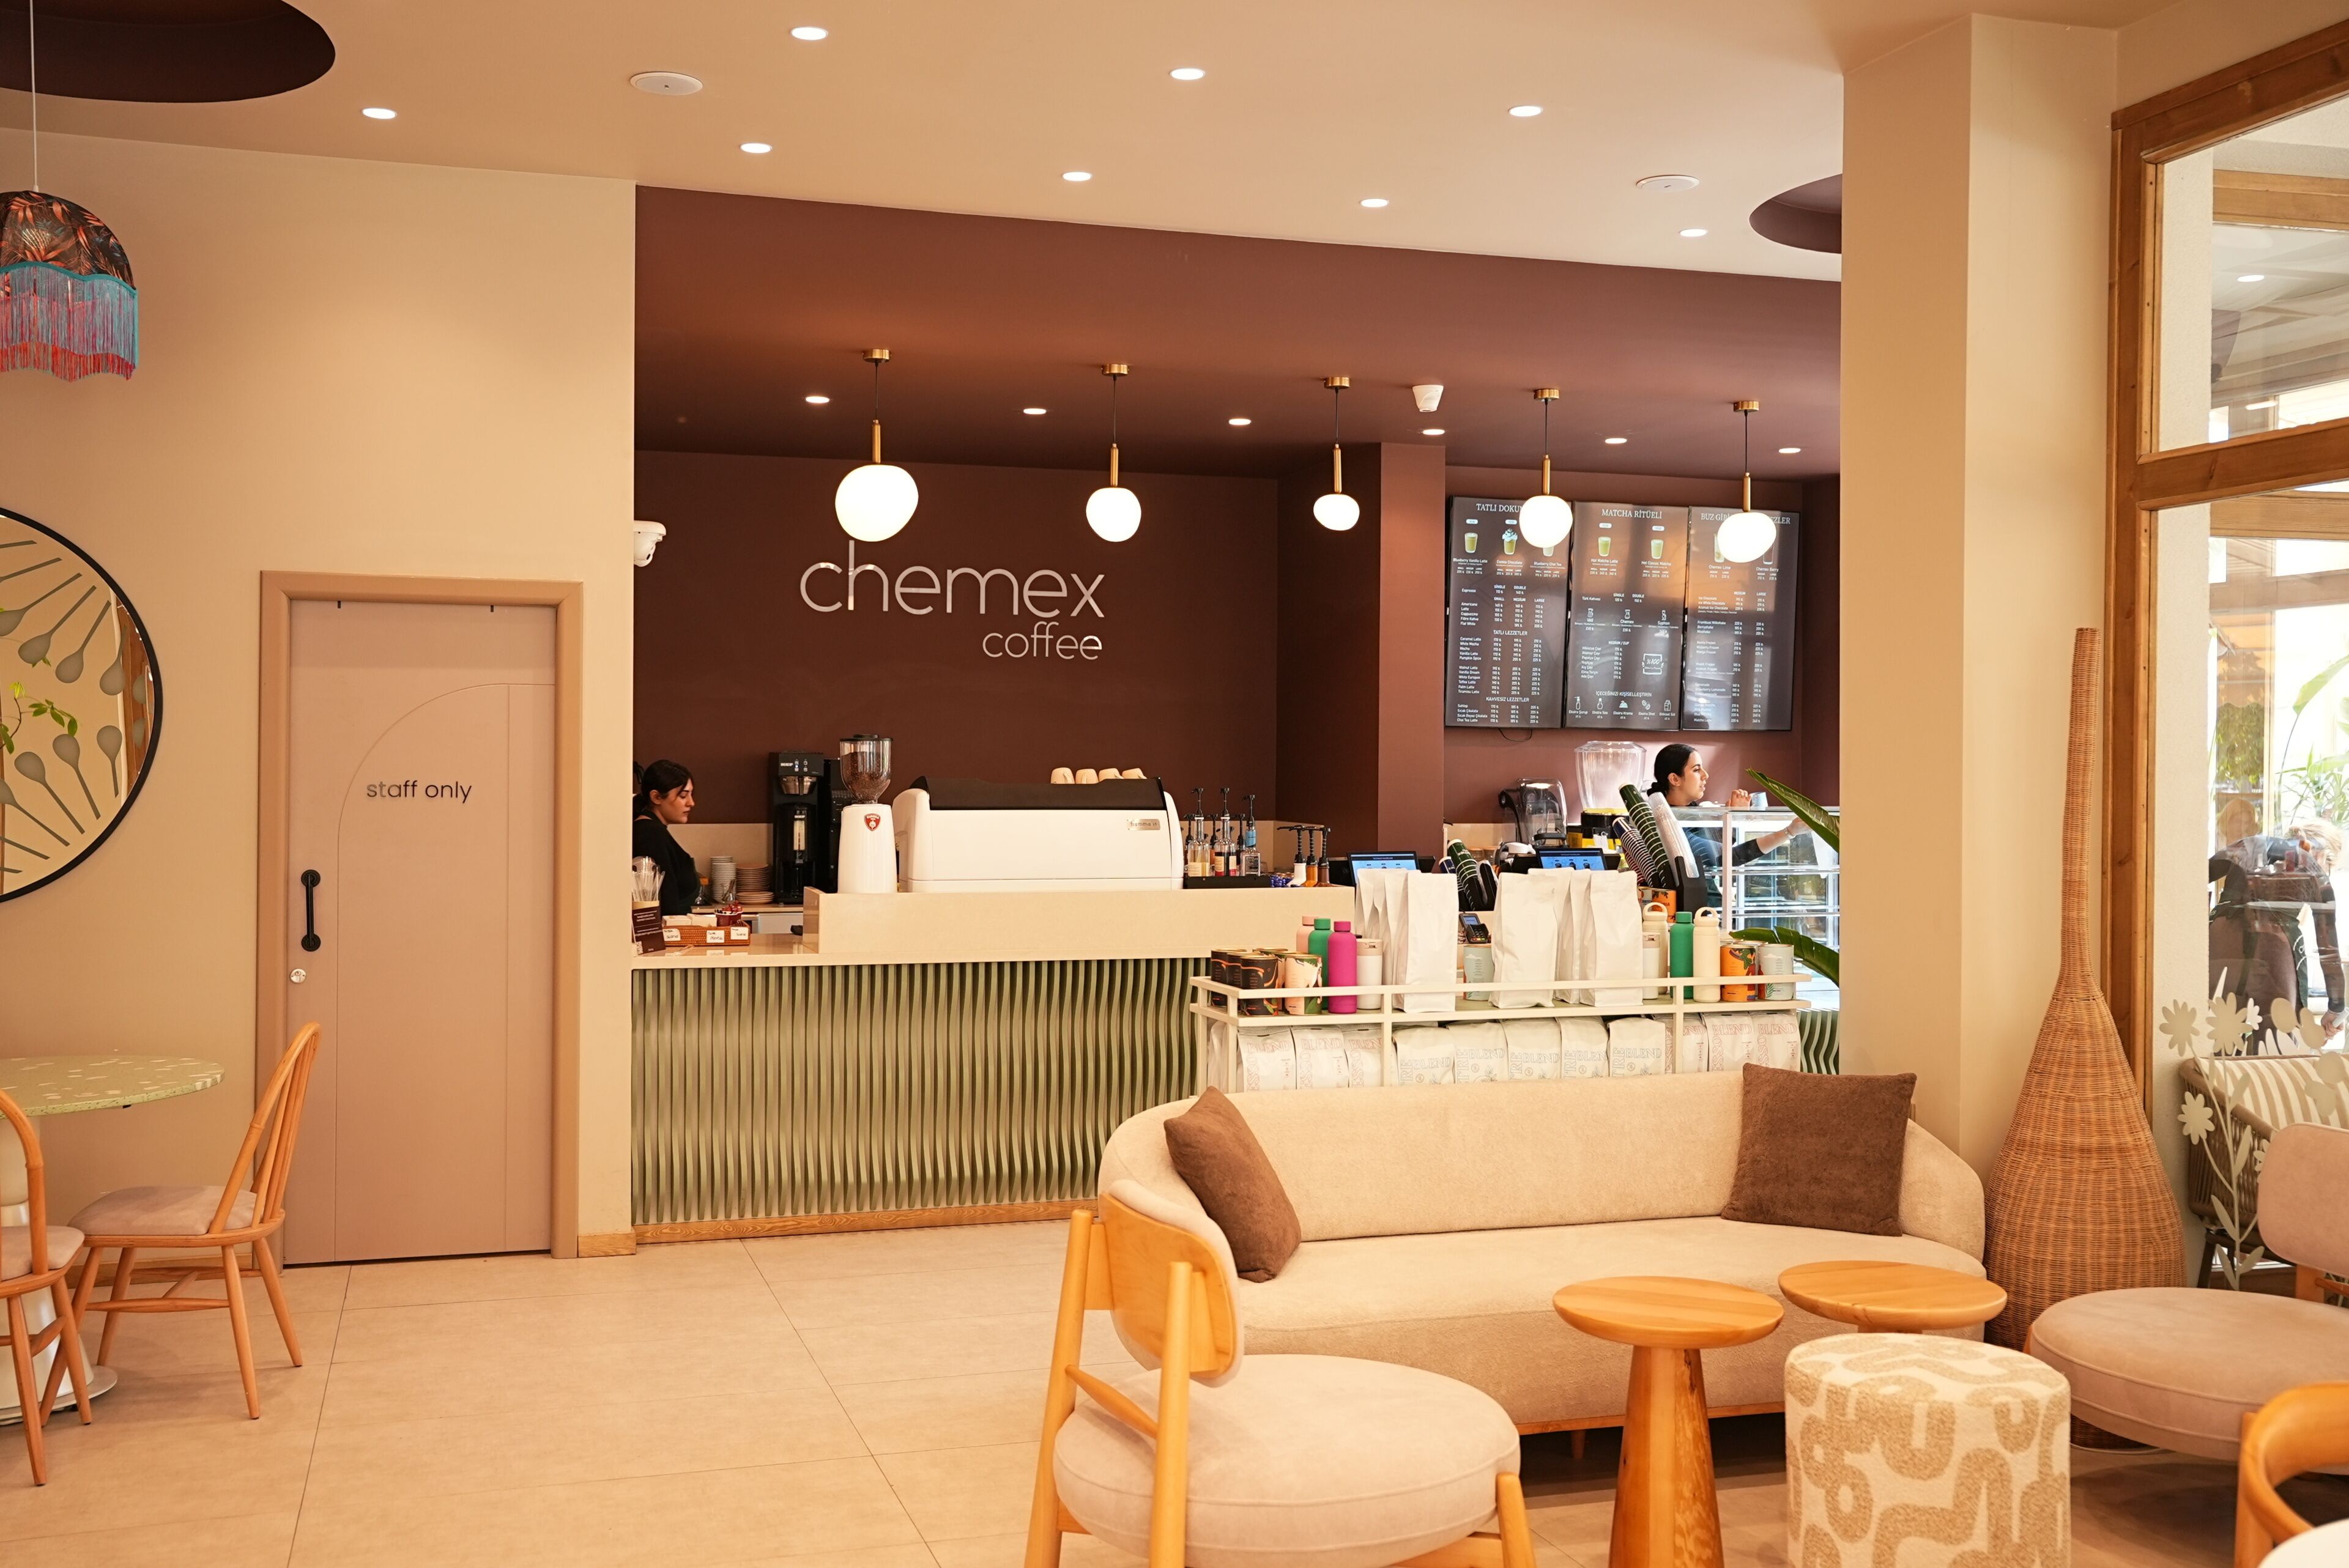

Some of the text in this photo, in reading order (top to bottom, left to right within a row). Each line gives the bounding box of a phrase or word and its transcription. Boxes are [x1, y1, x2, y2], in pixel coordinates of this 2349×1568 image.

[1602, 509, 1662, 519] MATCHA RİTÜELİ
[800, 541, 1105, 618] chemex
[982, 621, 1102, 660] coffee
[367, 780, 472, 804] staff only
[1712, 1024, 1752, 1035] BLEND
[1758, 1024, 1797, 1035] BLEND
[1247, 1040, 1292, 1053] BLEND
[1301, 1038, 1343, 1050] BLEND
[1349, 1038, 1382, 1049] BLEN
[1469, 1048, 1505, 1060] BLEND
[1523, 1052, 1560, 1063] BLEND
[1576, 1051, 1608, 1061] BLEN
[1625, 1048, 1662, 1059] BLEND
[1414, 1057, 1452, 1070] BLEND
